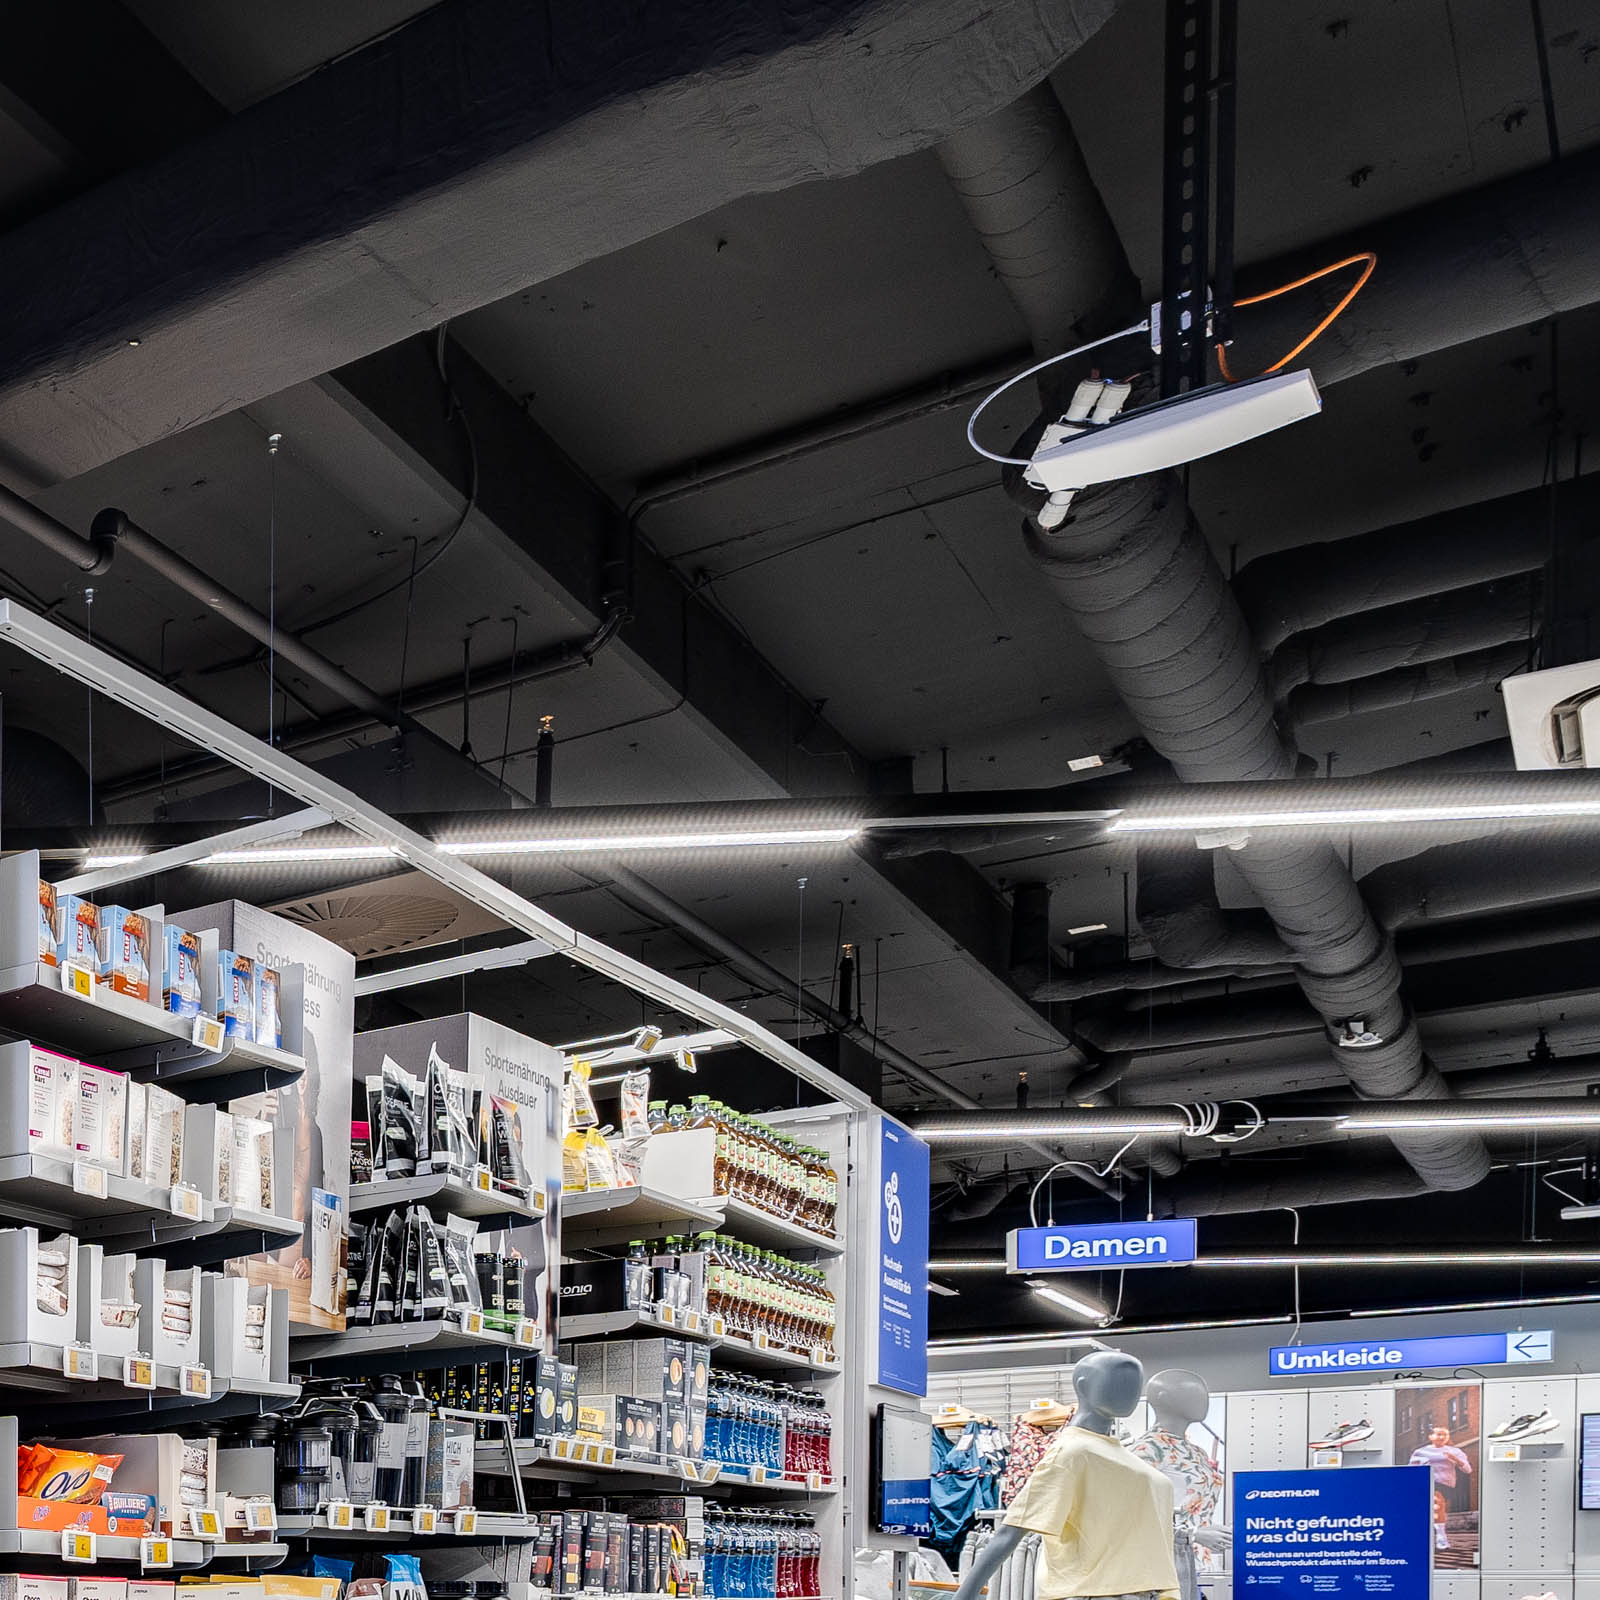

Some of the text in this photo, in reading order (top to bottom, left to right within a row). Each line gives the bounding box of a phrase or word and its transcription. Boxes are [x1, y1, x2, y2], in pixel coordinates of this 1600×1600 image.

[484, 1047, 551, 1091] Sporternährung
[498, 1079, 538, 1110] Ausdauer
[1044, 1234, 1167, 1261] Damen
[1277, 1346, 1403, 1371] Umkleide
[1259, 1488, 1320, 1499] DECATHLON
[112, 1496, 147, 1511] BUILDERS
[1245, 1514, 1385, 1531] Nicht gefunden
[1245, 1528, 1384, 1544] was du suchst?
[1245, 1550, 1275, 1560] Sprich
[1361, 1549, 1382, 1558] dein
[1245, 1558, 1319, 1568] Wunschprodukt
[1319, 1558, 1348, 1567] direkt
[1347, 1557, 1366, 1566] hier
[1366, 1557, 1378, 1566] im
